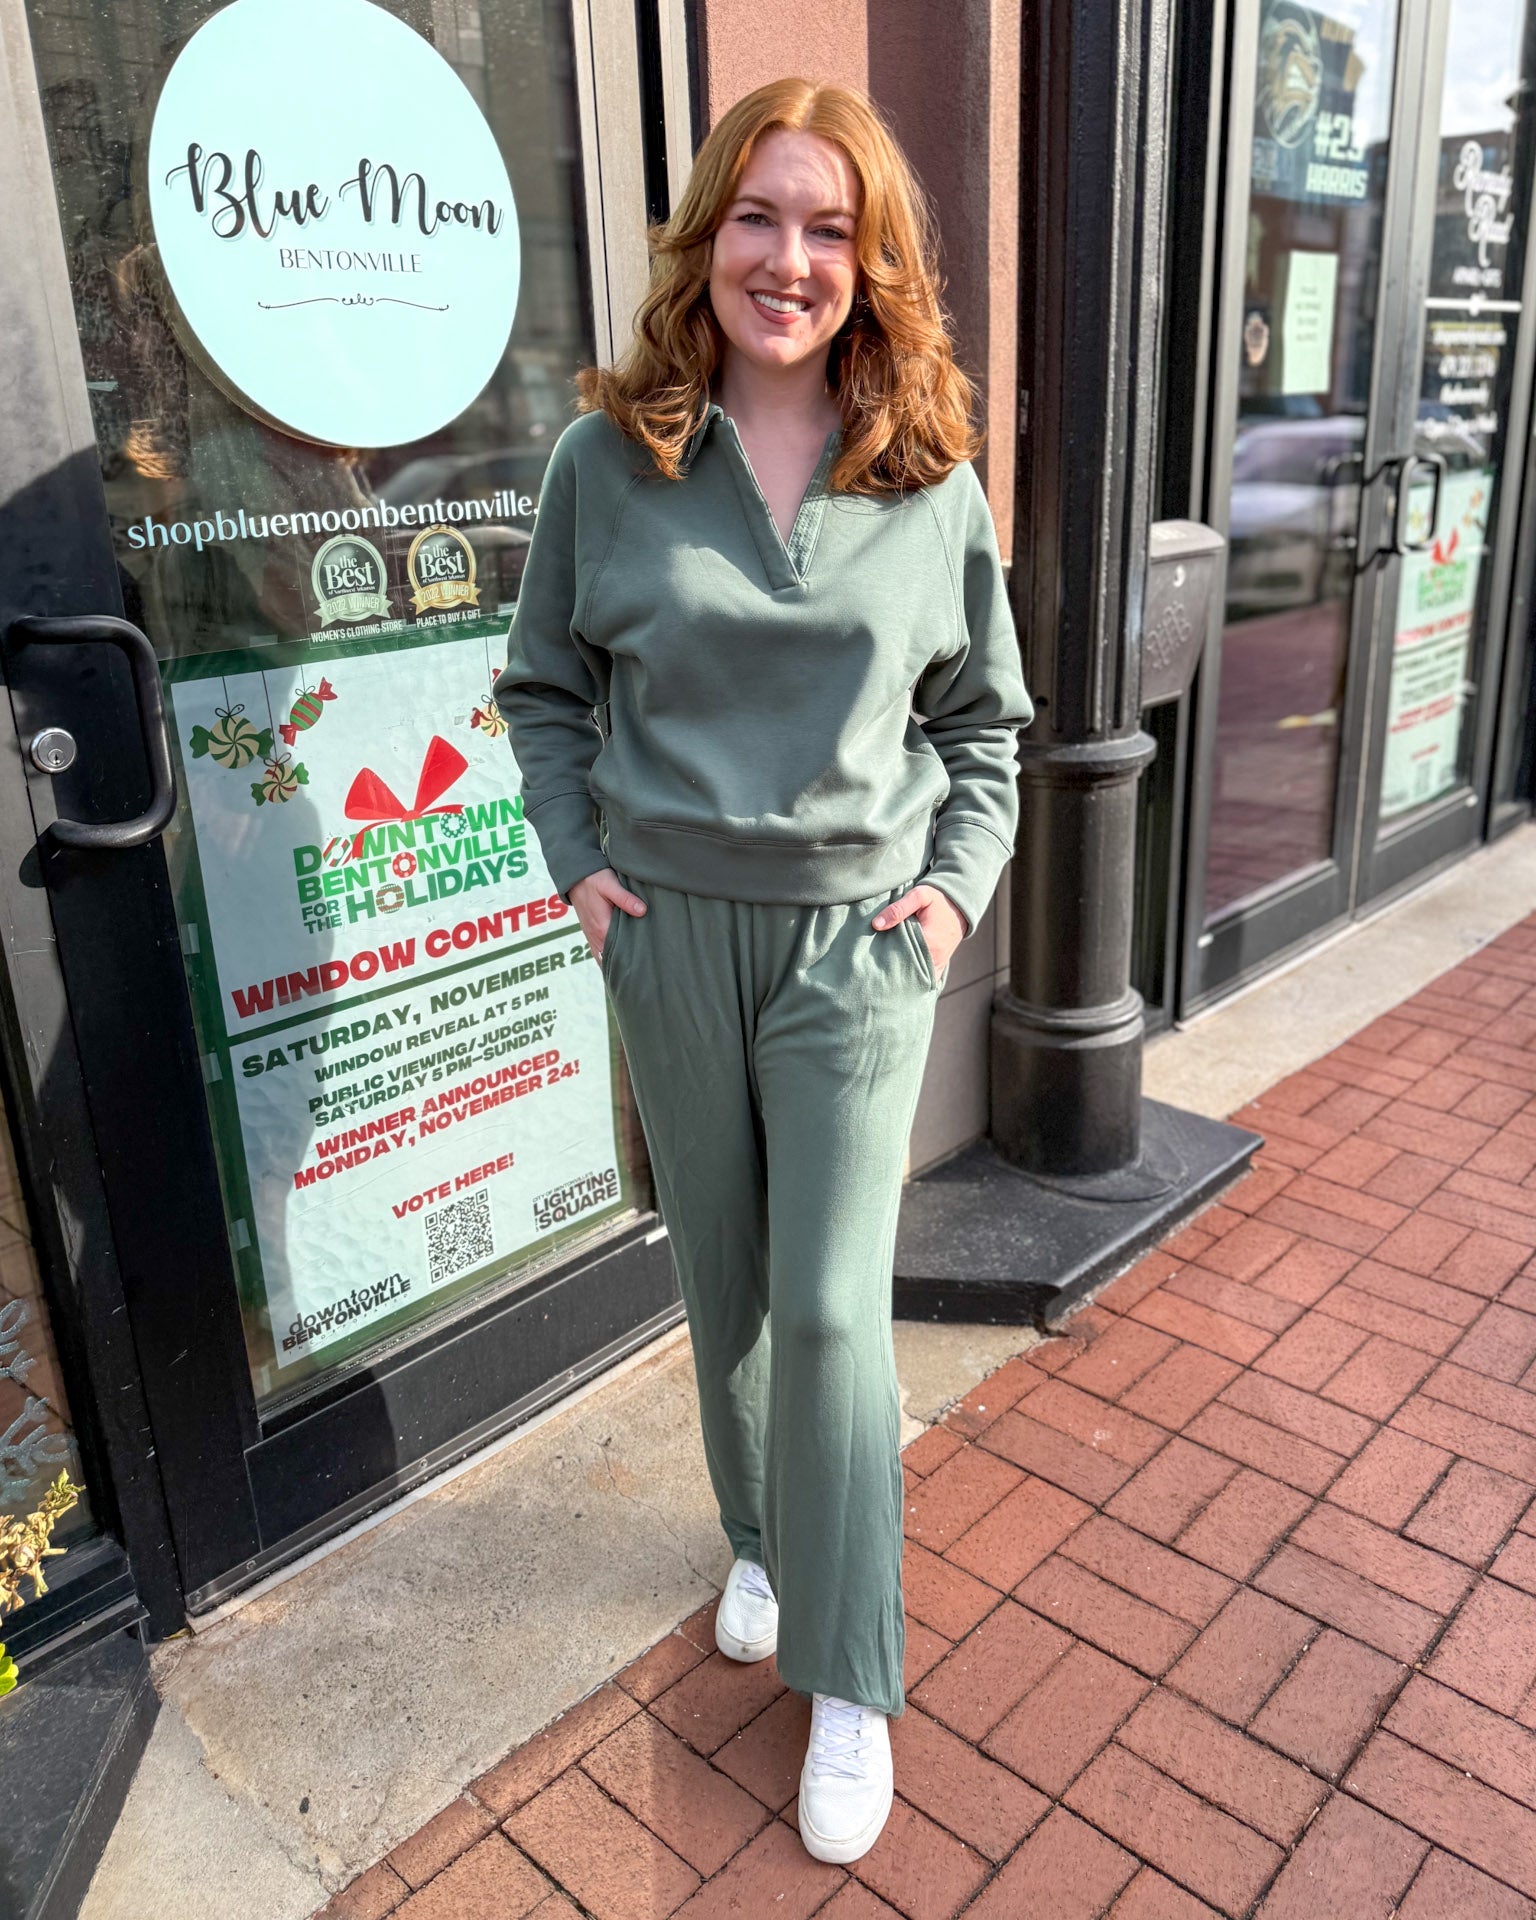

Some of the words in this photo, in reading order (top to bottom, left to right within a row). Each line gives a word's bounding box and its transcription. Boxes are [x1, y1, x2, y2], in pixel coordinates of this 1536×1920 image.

[166, 143, 328, 238] Blue
[339, 158, 502, 235] Moon
[1306, 162, 1369, 198] HARRIS
[280, 248, 423, 273] BENTONVILLE
[339, 555, 358, 569] the
[418, 551, 466, 579] Best
[432, 544, 449, 558] the
[323, 561, 376, 591] Best
[441, 584, 469, 599] WINNER
[348, 596, 380, 610] WINNER
[416, 616, 438, 628] PLACE
[438, 615, 447, 625] TO
[448, 613, 461, 623] BUY
[462, 612, 467, 621] A
[467, 608, 481, 619] GIFT
[310, 628, 346, 643] WOMEN'S
[347, 623, 381, 638] CLOTHING
[382, 619, 404, 633] STORE
[293, 796, 525, 876] DOWNTOWN
[297, 824, 526, 904] BENTONVILLE
[345, 850, 528, 924] HOLIDAYS
[301, 900, 339, 921] FOR
[304, 913, 342, 934] THE
[231, 938, 416, 1019] WINDOW
[242, 1004, 422, 1079] SATURDAY,
[431, 948, 566, 1014] NOVEMBER
[314, 1040, 402, 1083] WINDOW
[407, 1014, 479, 1049] REVEAL
[483, 1002, 507, 1023] AT
[511, 996, 522, 1011] 5
[524, 987, 549, 1005] PM
[308, 1075, 384, 1114] PUBLIC
[315, 1073, 427, 1127] SATURDAY
[432, 1067, 444, 1082] 5
[315, 1106, 417, 1159] WINNER
[421, 1049, 560, 1118] ANNOUNCED
[294, 1130, 416, 1190] MONDAY,
[419, 1076, 543, 1138] NOVEMBER
[547, 1059, 581, 1085] 24!
[392, 1181, 451, 1219] VOTE
[455, 1152, 515, 1193] HERE!
[533, 1168, 617, 1217] LIGHTING
[539, 1181, 618, 1230] SQUARE
[282, 1279, 411, 1351] BENTONVILLE
[289, 1273, 403, 1336] downtown
